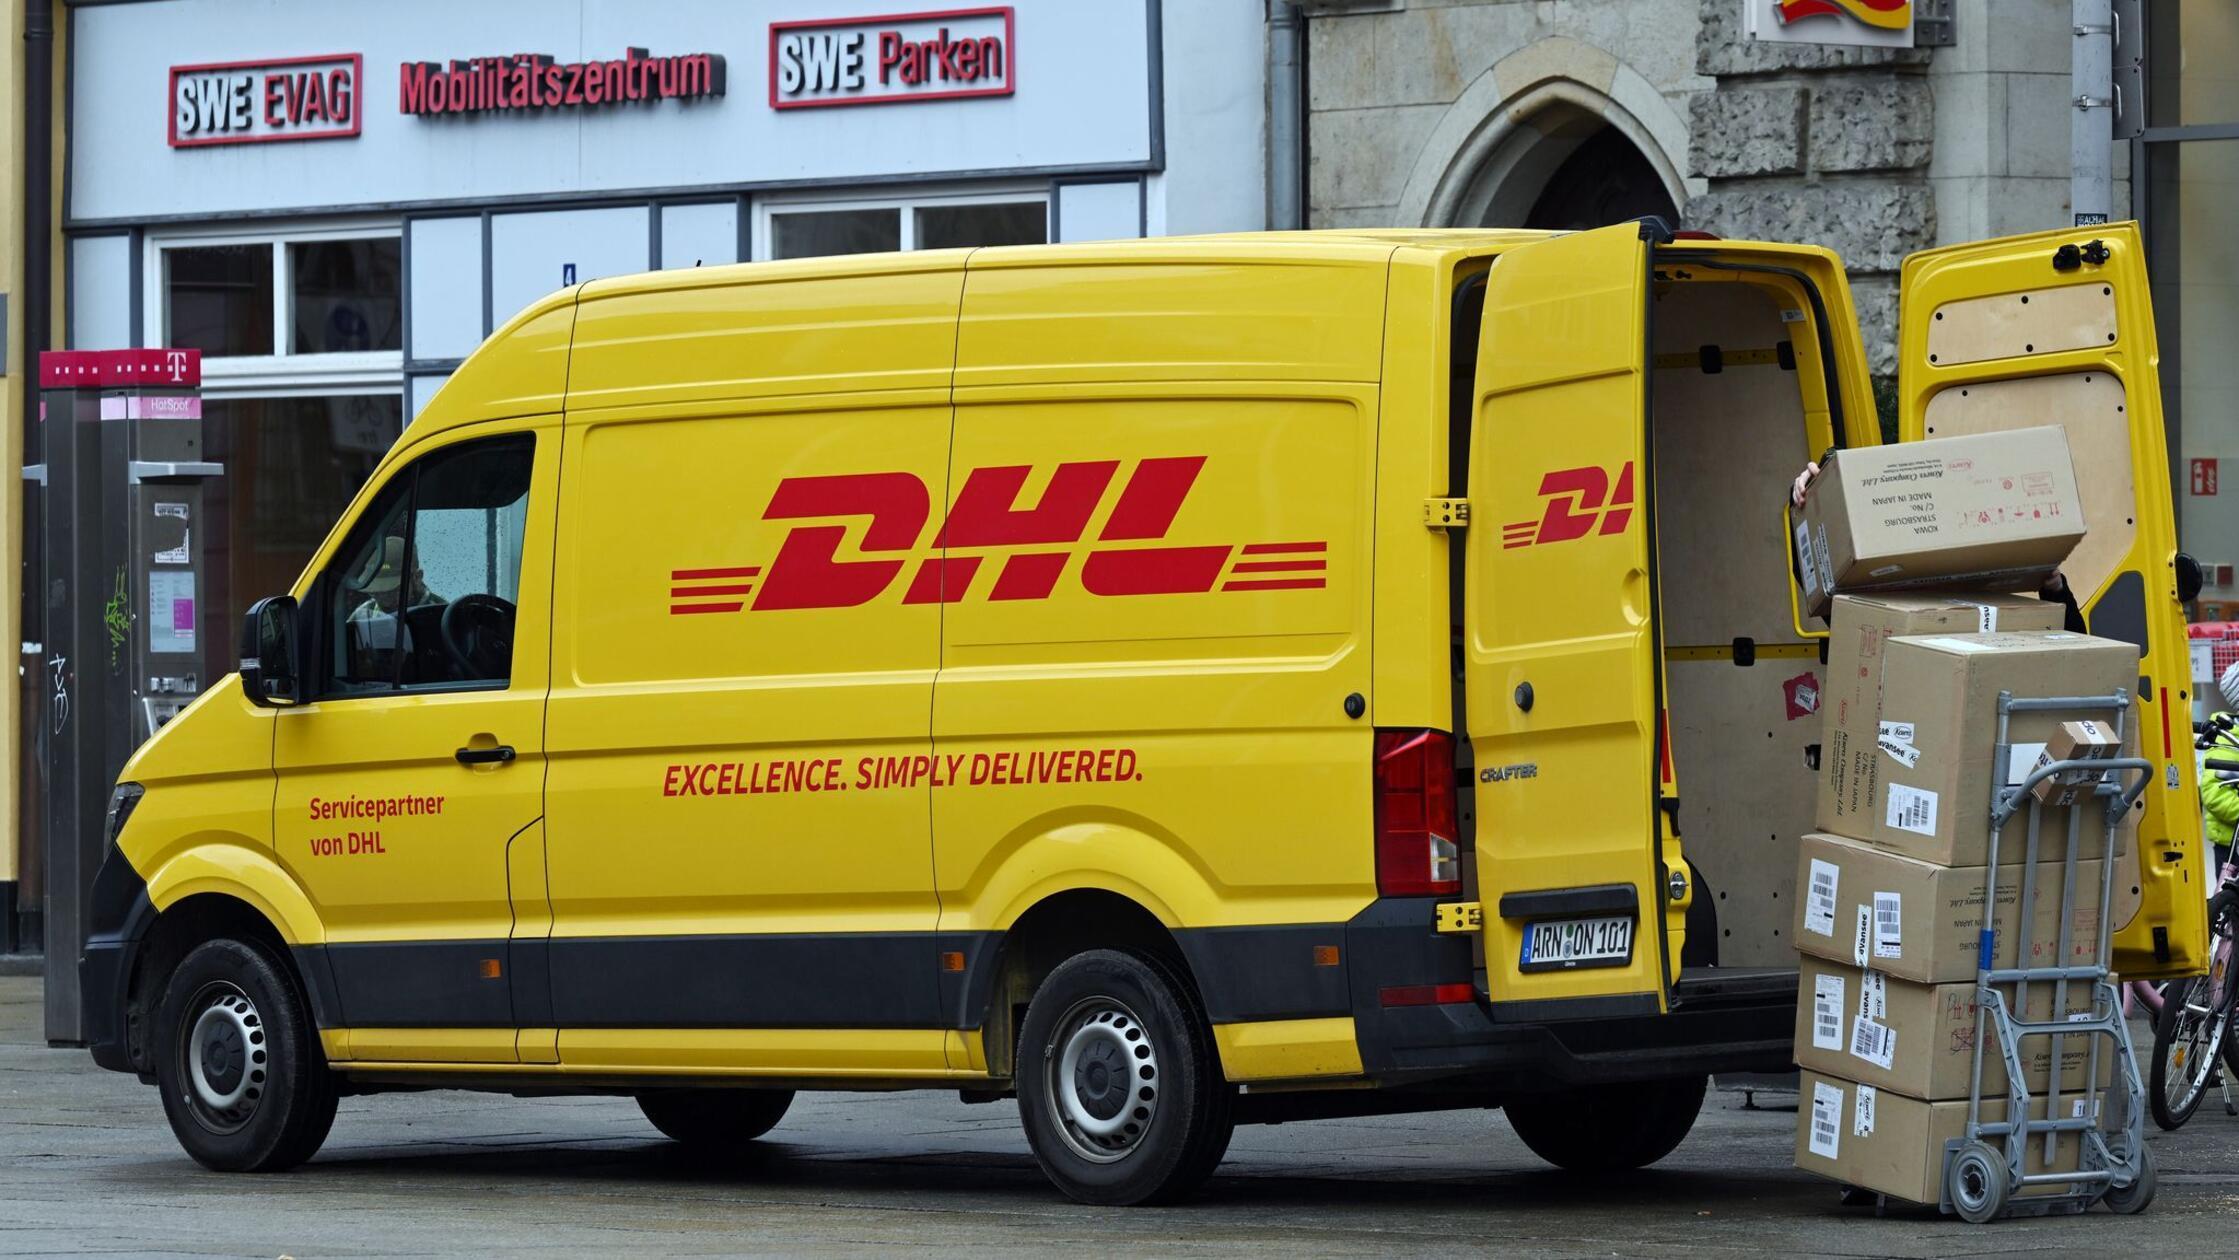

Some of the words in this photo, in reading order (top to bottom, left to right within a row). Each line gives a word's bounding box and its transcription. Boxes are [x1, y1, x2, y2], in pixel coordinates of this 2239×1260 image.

[778, 33, 863, 94] SWE
[879, 28, 1002, 85] Parken
[400, 47, 717, 114] Mobilitätszentrum
[177, 75, 252, 133] SWE
[264, 68, 350, 127] EVAG
[151, 399, 189, 412] HotSpot
[1872, 495, 1897, 505] JAPAN
[1898, 494, 1908, 502] IN
[1909, 492, 1932, 501] MADE
[1884, 513, 1937, 527] STRASBOURG
[1914, 525, 1938, 535] KOWA
[750, 456, 1233, 611] DHL
[663, 759, 848, 797] EXCELLENCE.
[855, 754, 969, 791] SIMPLY
[969, 749, 1143, 786] DELIVERED.
[1480, 763, 1537, 782] CRAFTER
[1867, 754, 1877, 808] STRASBOURG
[310, 794, 445, 822] Servicepartner
[310, 837, 343, 856] von
[348, 831, 386, 854] DHL
[1531, 924, 1563, 959] ARN
[1572, 922, 1595, 955] ON
[1596, 921, 1628, 954] 101
